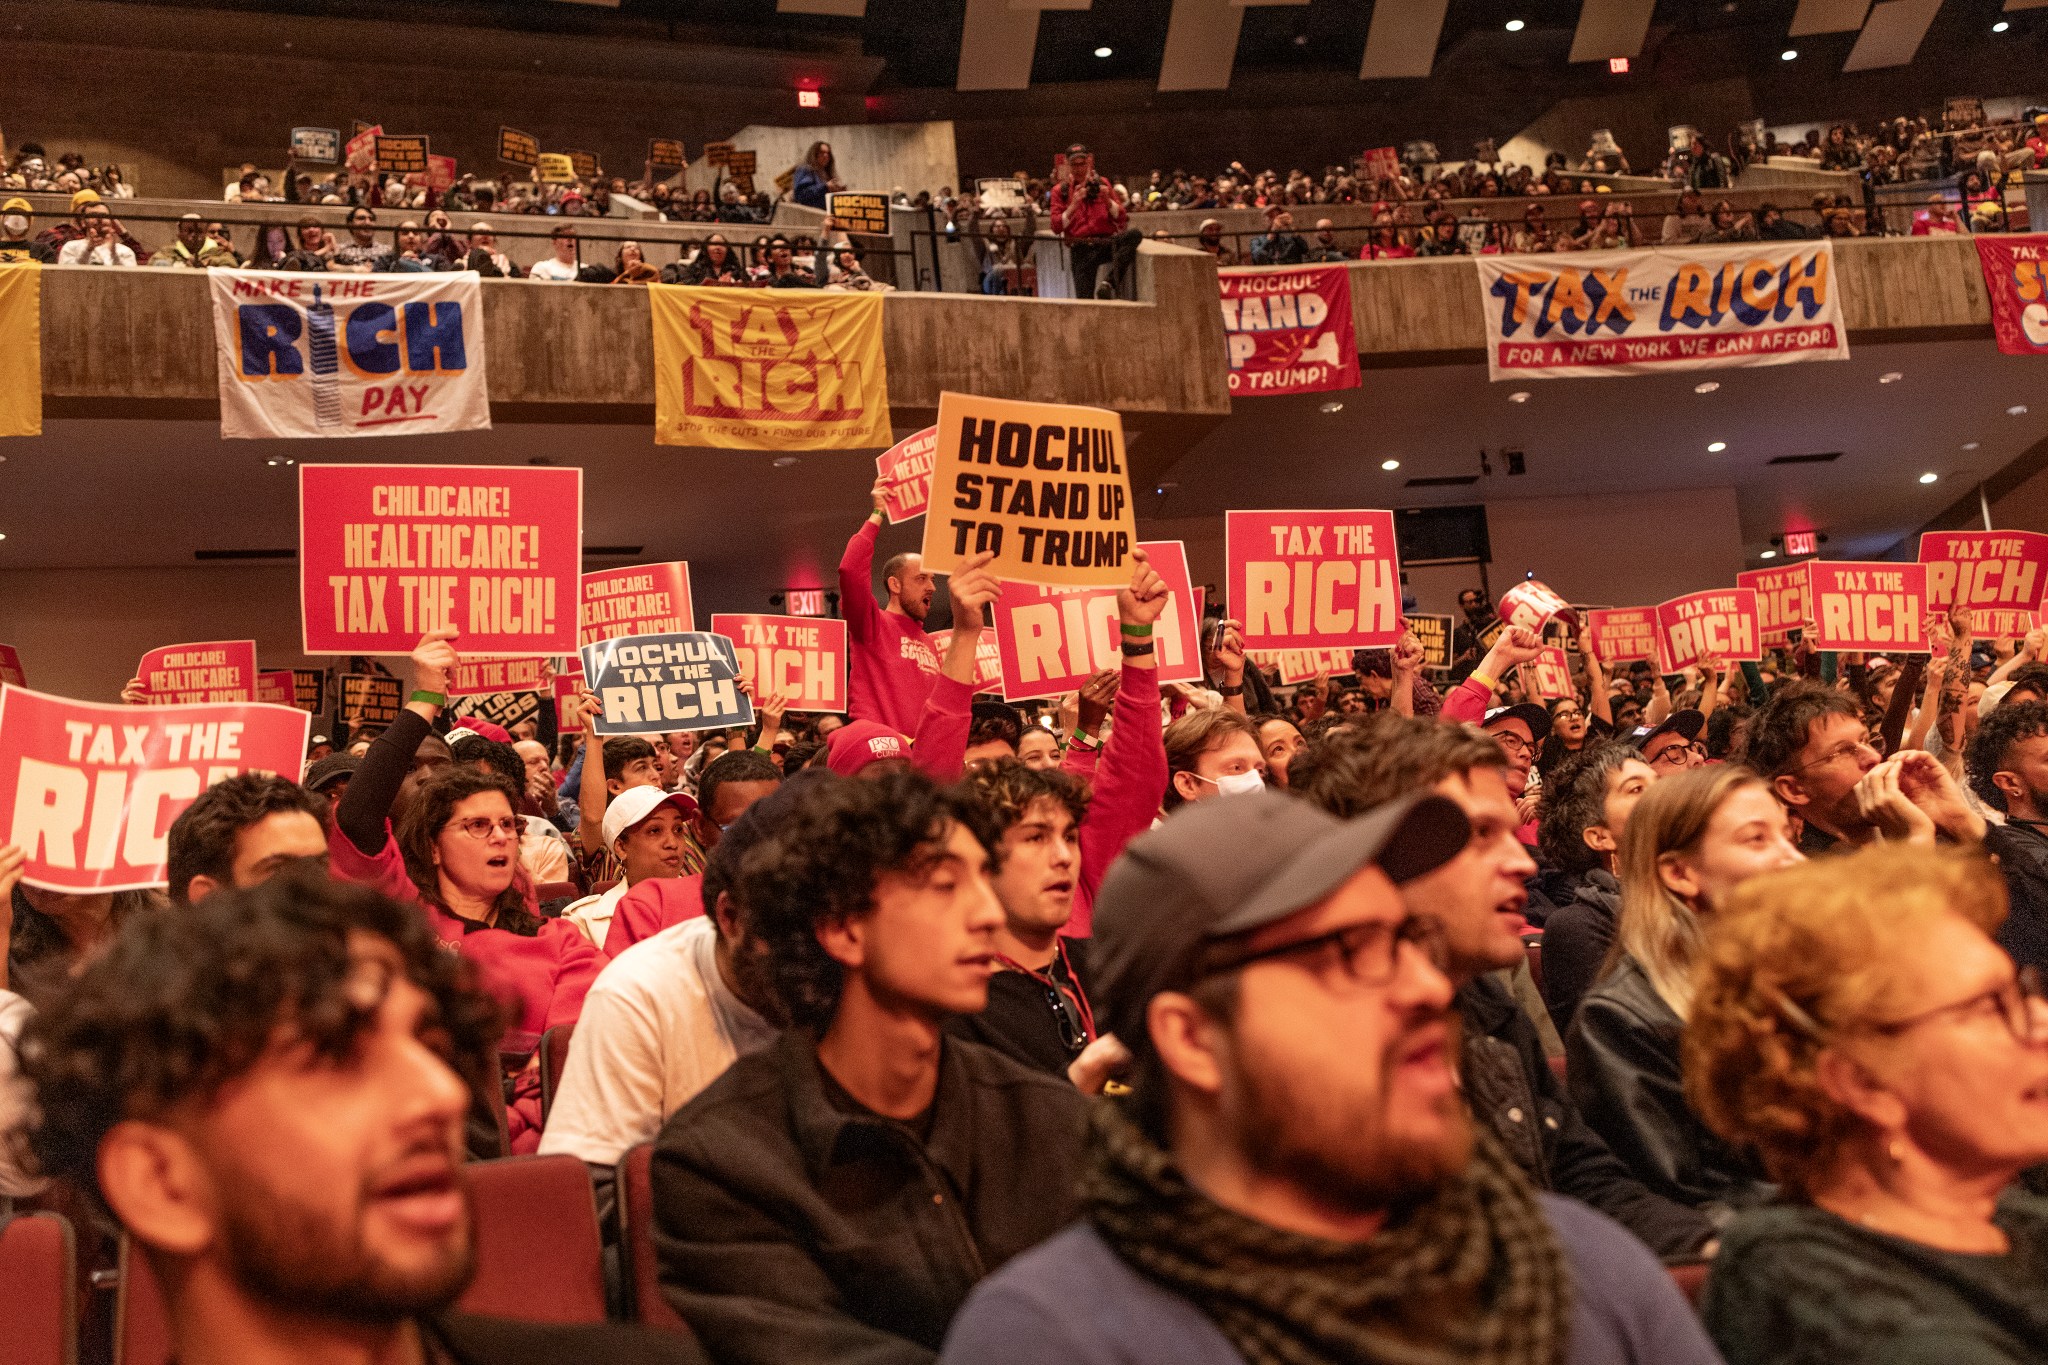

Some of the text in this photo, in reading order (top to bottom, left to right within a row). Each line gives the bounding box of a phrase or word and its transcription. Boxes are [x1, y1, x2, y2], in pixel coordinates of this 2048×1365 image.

[834, 195, 885, 208] HOCHUL
[835, 207, 863, 218] WHICH
[2011, 246, 2040, 259] TAX
[232, 279, 377, 298] MAKE THE
[1490, 250, 1829, 338] TAX THE RICH
[1220, 292, 1328, 333] TAND
[233, 300, 468, 383] RICH
[689, 299, 842, 362] TAX
[1506, 327, 1832, 364] FOR A NEW YORK WE CAN AFFORD
[750, 346, 776, 357] THE
[1225, 333, 1257, 370] P
[681, 354, 865, 422] RICH
[1227, 366, 1328, 390] O TRUMP!
[361, 384, 430, 417] PAY
[677, 422, 872, 438] STOP THE CUTS FUND OUR FUTURE
[903, 434, 938, 458] CHILDC
[957, 416, 1122, 475] HOCHUL
[894, 450, 935, 482] HEALT
[372, 485, 510, 518] CHILDCARE!
[893, 478, 926, 511] TAX
[954, 472, 1125, 521] STAND UP
[344, 523, 539, 570] HEALTHCARE!
[950, 518, 1128, 568] TO TRUMP
[1270, 524, 1375, 556] TAX THE
[1789, 534, 1815, 554] EXIT
[1947, 538, 2025, 560] TAX THE
[585, 574, 653, 600] CHILDCARE!
[1757, 568, 1808, 594] TAX THE
[1834, 570, 1904, 592] TAX THE
[1929, 559, 2038, 605] RICH
[328, 575, 556, 635] TAX THE RICH!
[788, 590, 822, 616] EXIT
[1245, 559, 1396, 636] RICH
[1676, 595, 1737, 620] TAX THE
[1821, 592, 1920, 643] RICH
[1994, 611, 2016, 633] THE
[741, 624, 819, 648] TAX THE
[1598, 639, 1617, 657] TAX
[1616, 638, 1634, 656] THE
[1668, 613, 1753, 664] RICH
[163, 650, 226, 669] CHILDCARE!
[595, 640, 727, 670] HOCHUL
[150, 667, 240, 692] HEALTHCARE!
[345, 679, 400, 695] HOCHUL
[456, 659, 540, 689] TAX THE RICH!
[619, 663, 712, 684] TAX THE
[1537, 662, 1569, 695] CH
[345, 693, 399, 709] WHICH SIDE
[365, 707, 381, 720] YOU
[484, 692, 516, 715] LOS
[602, 678, 738, 725] RICH
[64, 719, 245, 766] TAX THE
[871, 738, 899, 752] PSC
[10, 756, 278, 871] RIC
